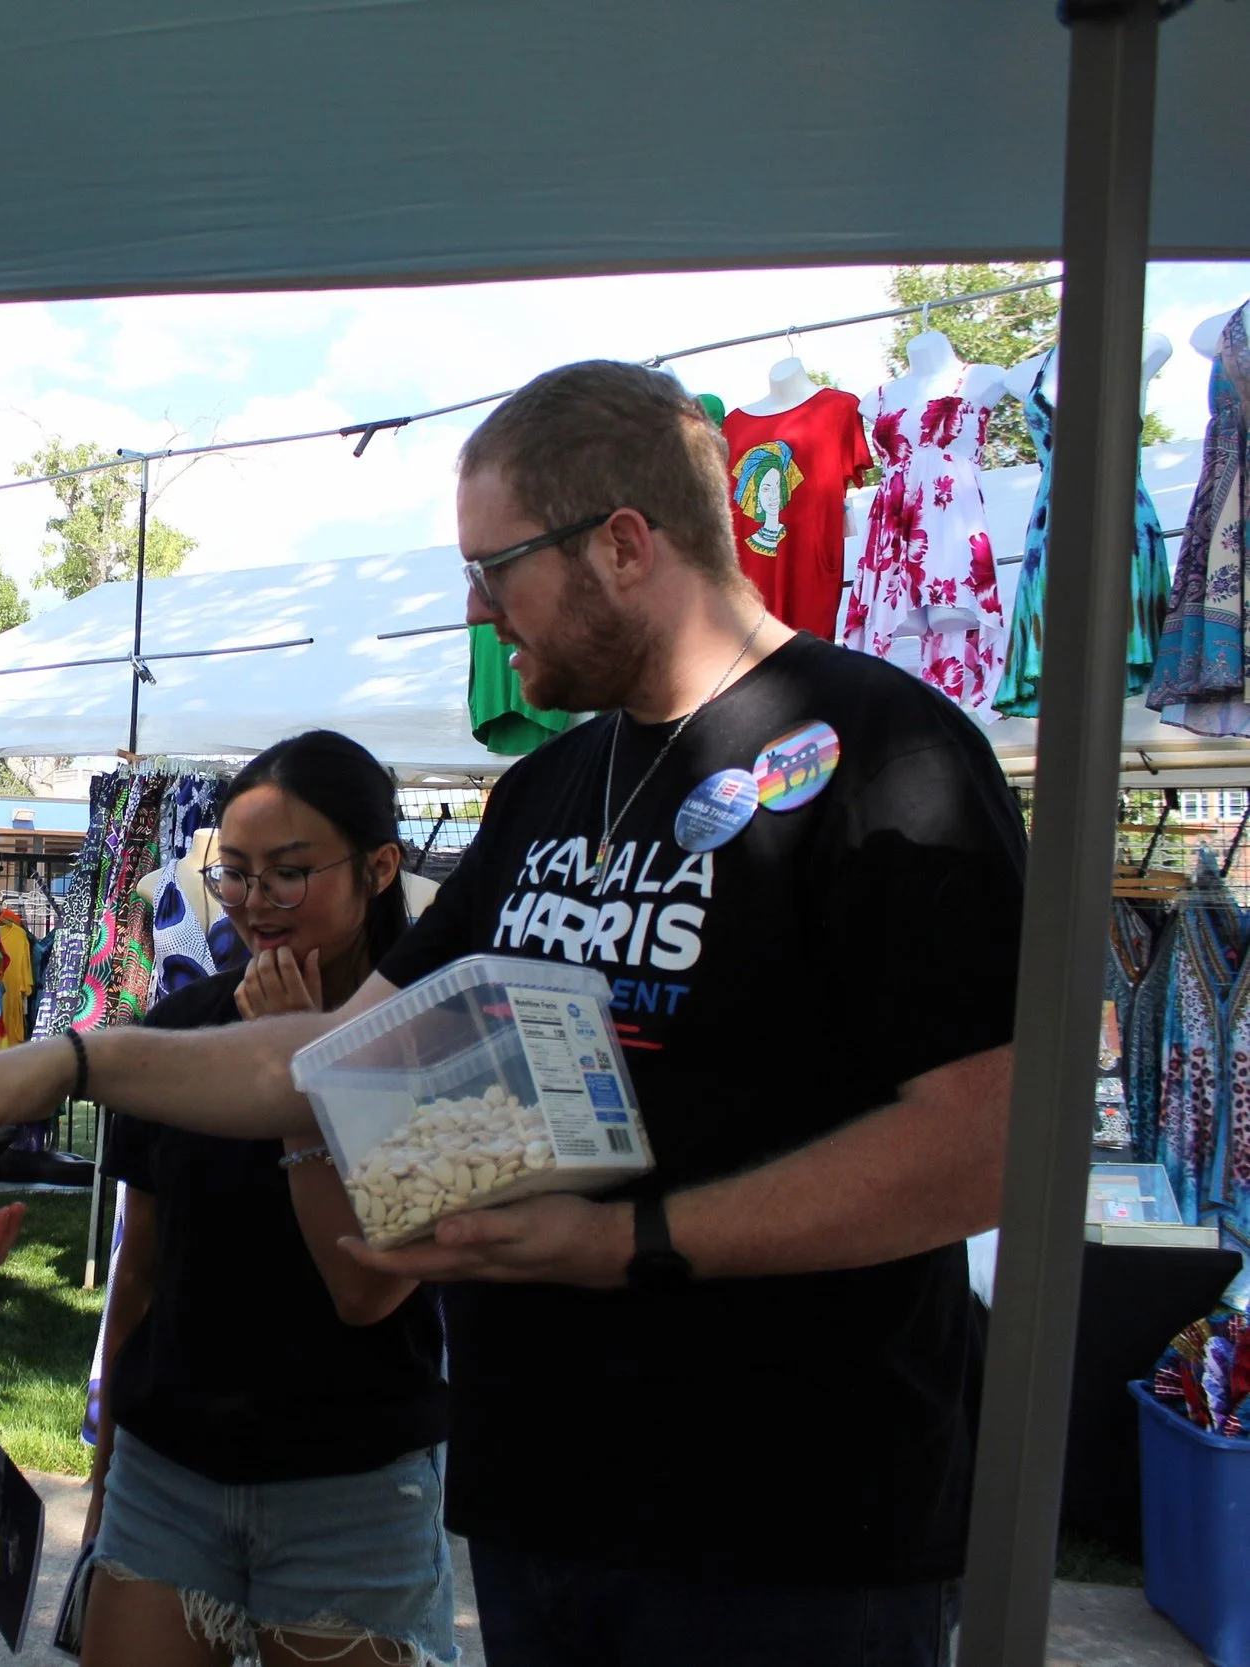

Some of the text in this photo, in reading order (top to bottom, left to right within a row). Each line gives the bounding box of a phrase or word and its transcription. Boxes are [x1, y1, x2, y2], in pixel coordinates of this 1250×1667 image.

[690, 800, 711, 814] WAS
[710, 807, 741, 825] THERE
[493, 892, 706, 971] HARRIS
